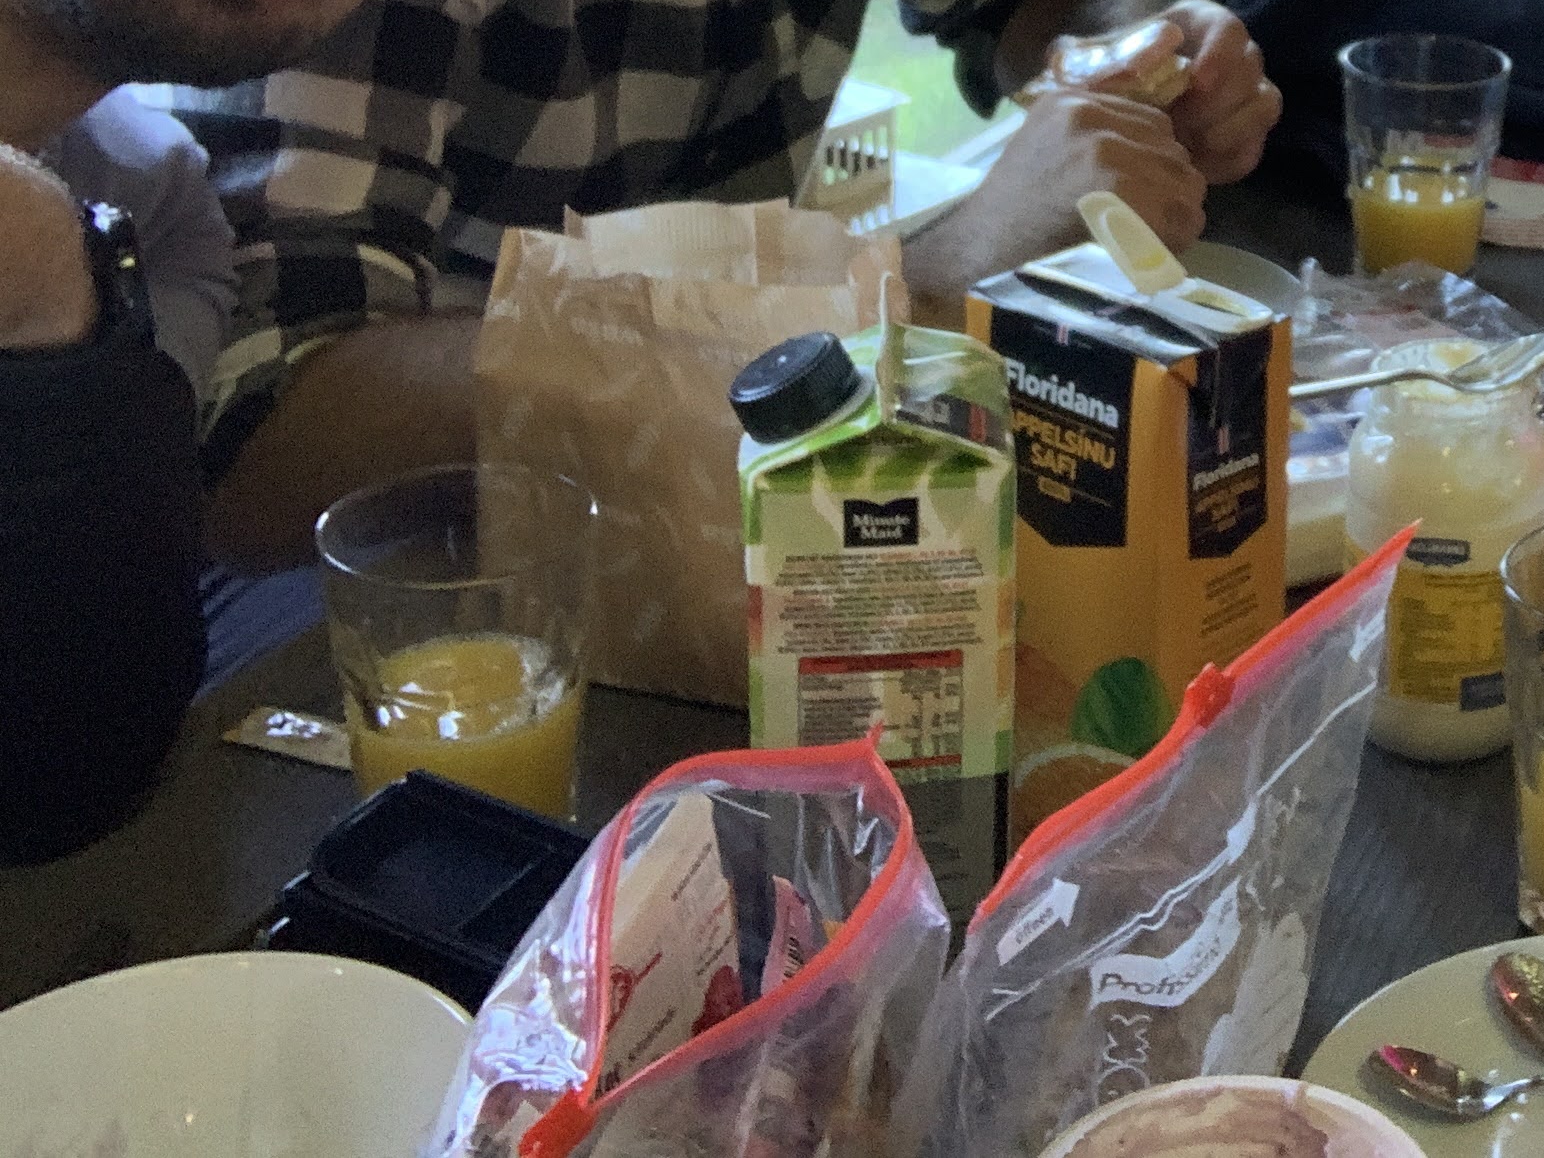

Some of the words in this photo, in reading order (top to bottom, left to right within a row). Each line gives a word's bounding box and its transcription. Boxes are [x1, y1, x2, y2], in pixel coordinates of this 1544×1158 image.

[1005, 356, 1119, 428] Floridana
[1031, 442, 1077, 481] SAFI
[852, 513, 910, 527] Minute
[860, 526, 902, 540] Maid
